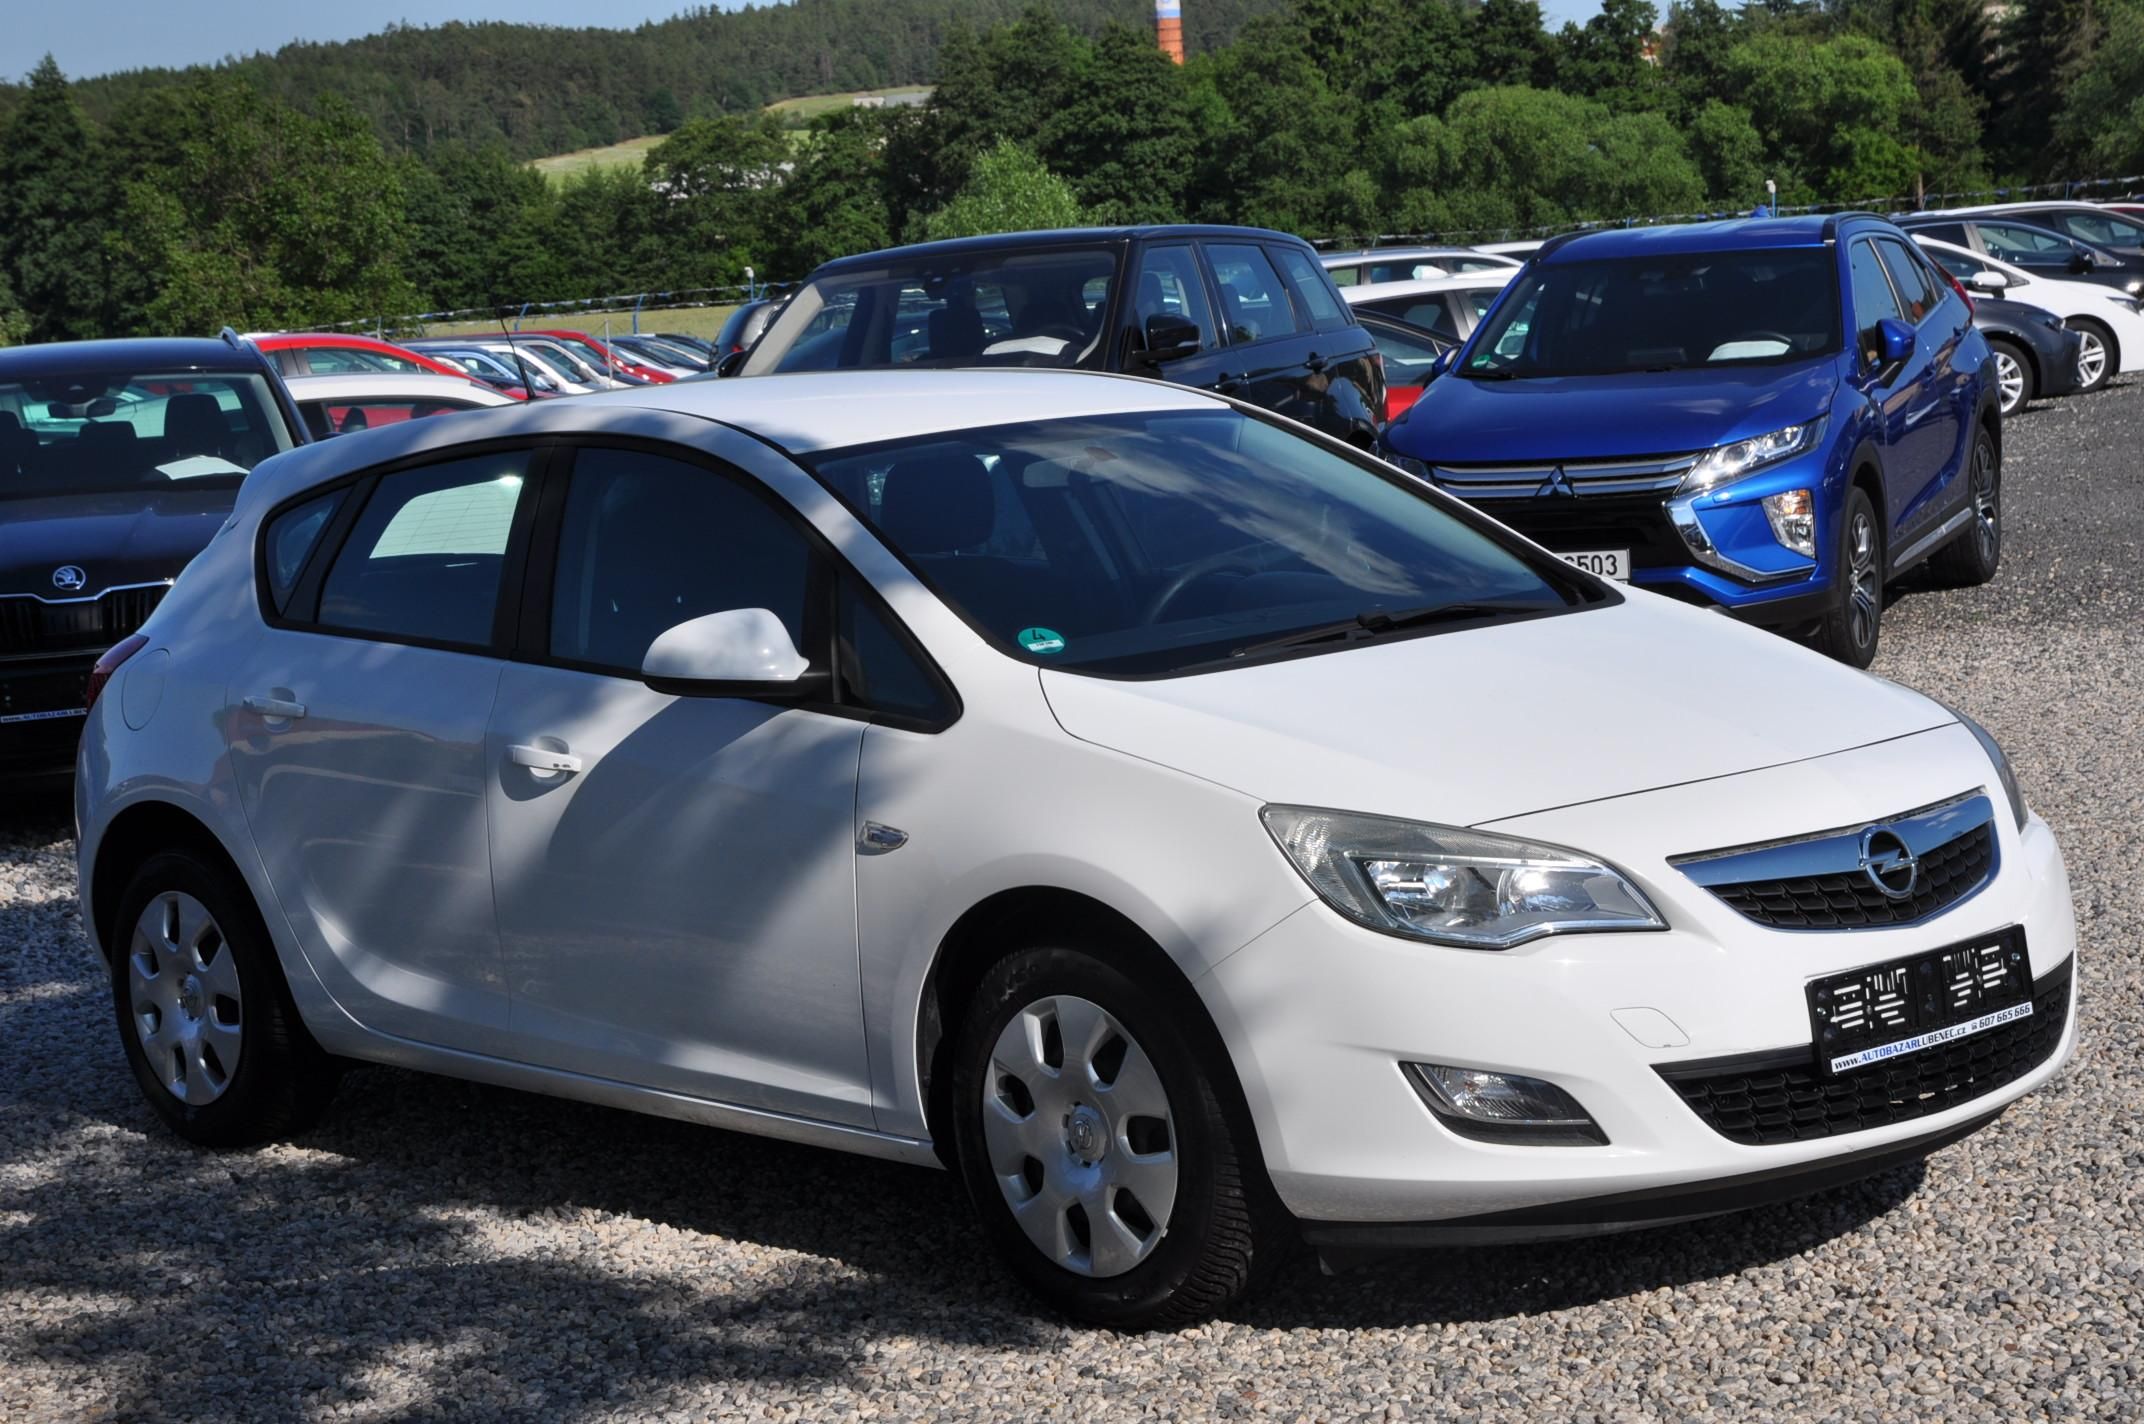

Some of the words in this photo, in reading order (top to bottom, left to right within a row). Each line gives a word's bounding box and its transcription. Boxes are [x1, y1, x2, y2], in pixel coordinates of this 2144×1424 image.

[1979, 1016, 1996, 1028] 607
[1997, 1011, 2013, 1023] 665
[2014, 1004, 2031, 1017] 666
